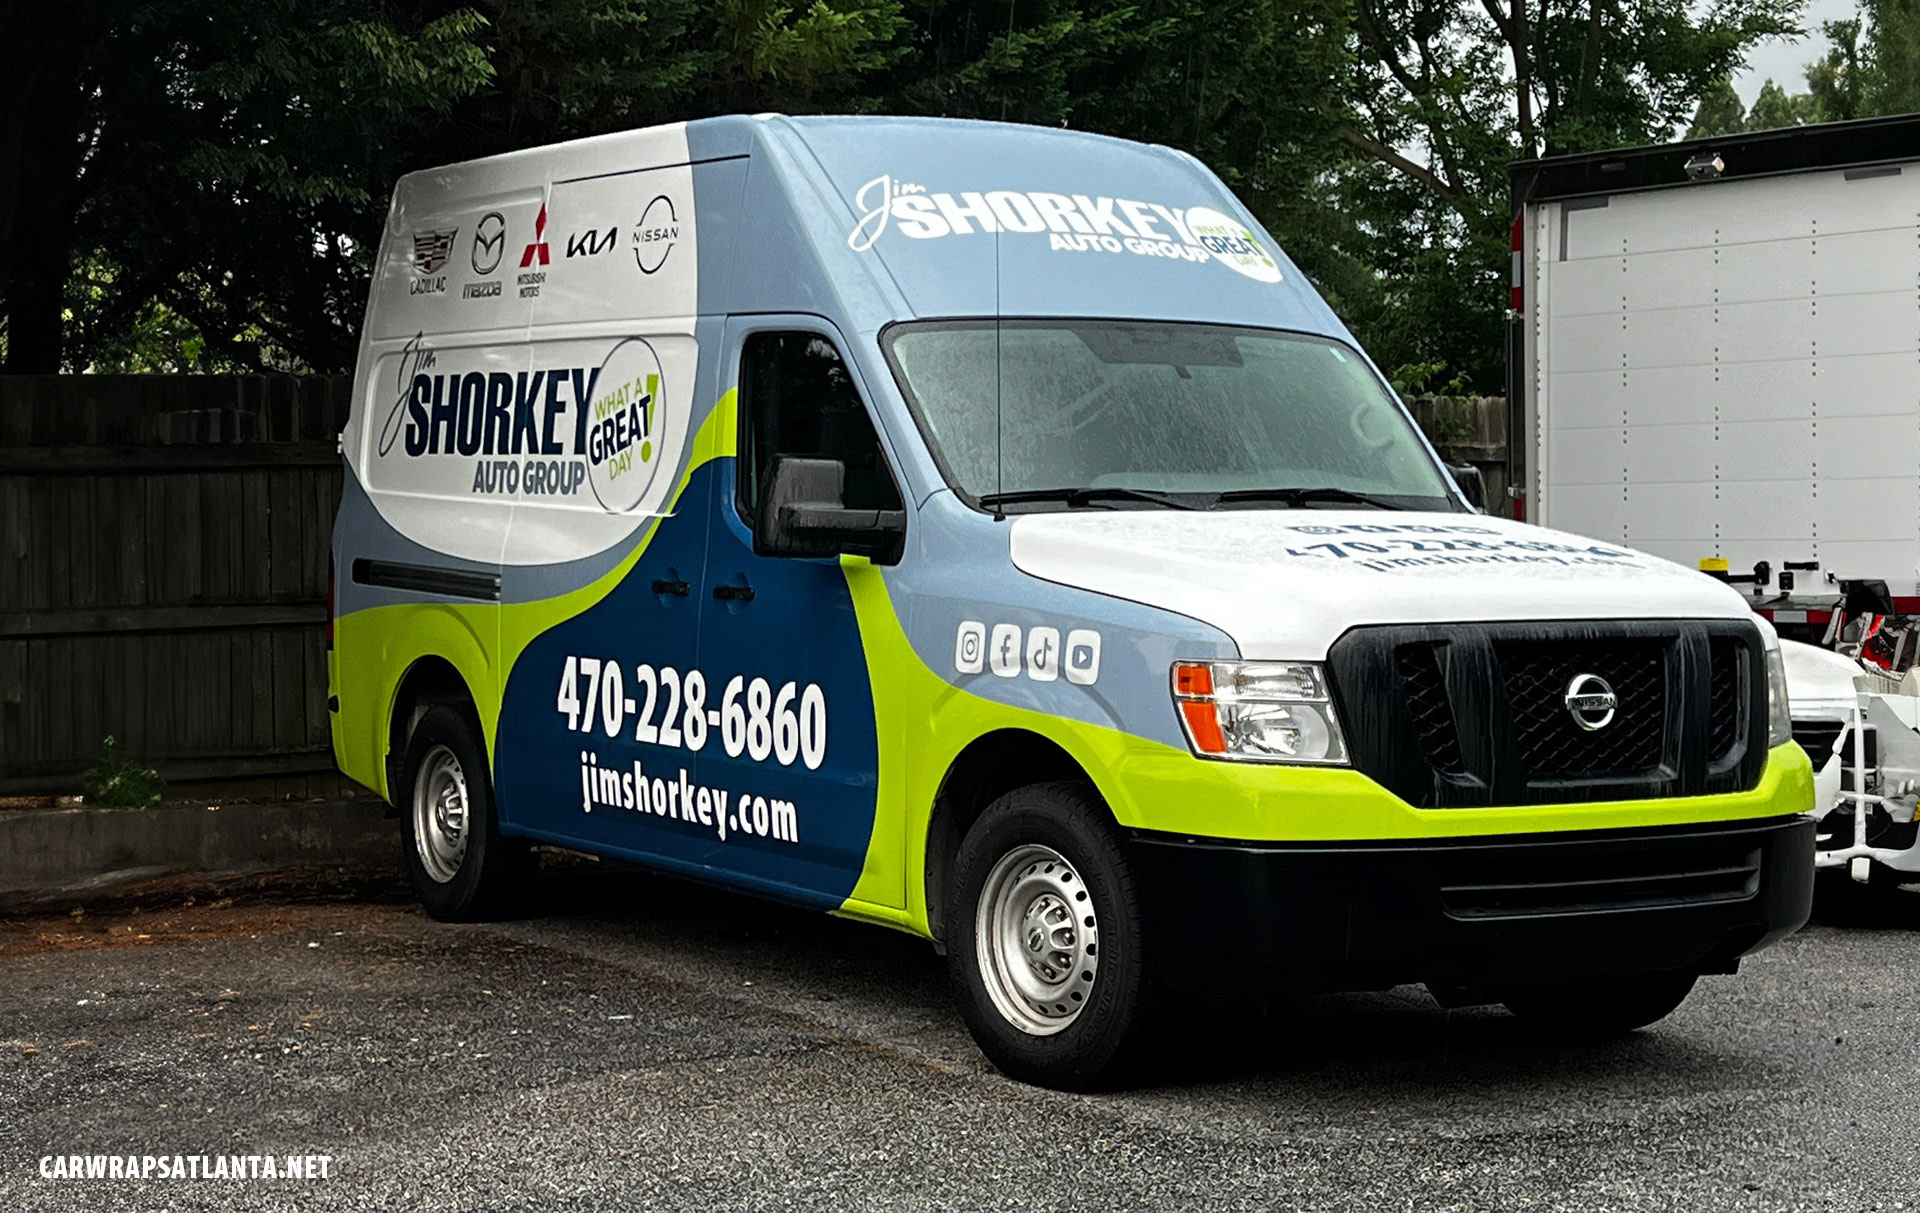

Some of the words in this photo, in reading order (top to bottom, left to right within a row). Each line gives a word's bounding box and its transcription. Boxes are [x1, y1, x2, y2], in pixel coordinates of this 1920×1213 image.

[632, 226, 679, 243] NISSAN
[848, 175, 926, 252] Jim
[891, 190, 1191, 246] SHORKEY
[1049, 232, 1122, 254] AUTO
[1126, 237, 1209, 263] GROUP
[410, 276, 446, 295] CADILLAC
[379, 331, 436, 457] Jim
[405, 367, 602, 457] SHORKEY
[595, 383, 630, 420] WHAT
[635, 377, 643, 399] A
[472, 460, 519, 493] AUTO
[522, 461, 585, 496] GROUP
[609, 446, 633, 481] DAY
[557, 656, 827, 770] 470-228-6860
[581, 751, 798, 842] jimshorkey.com
